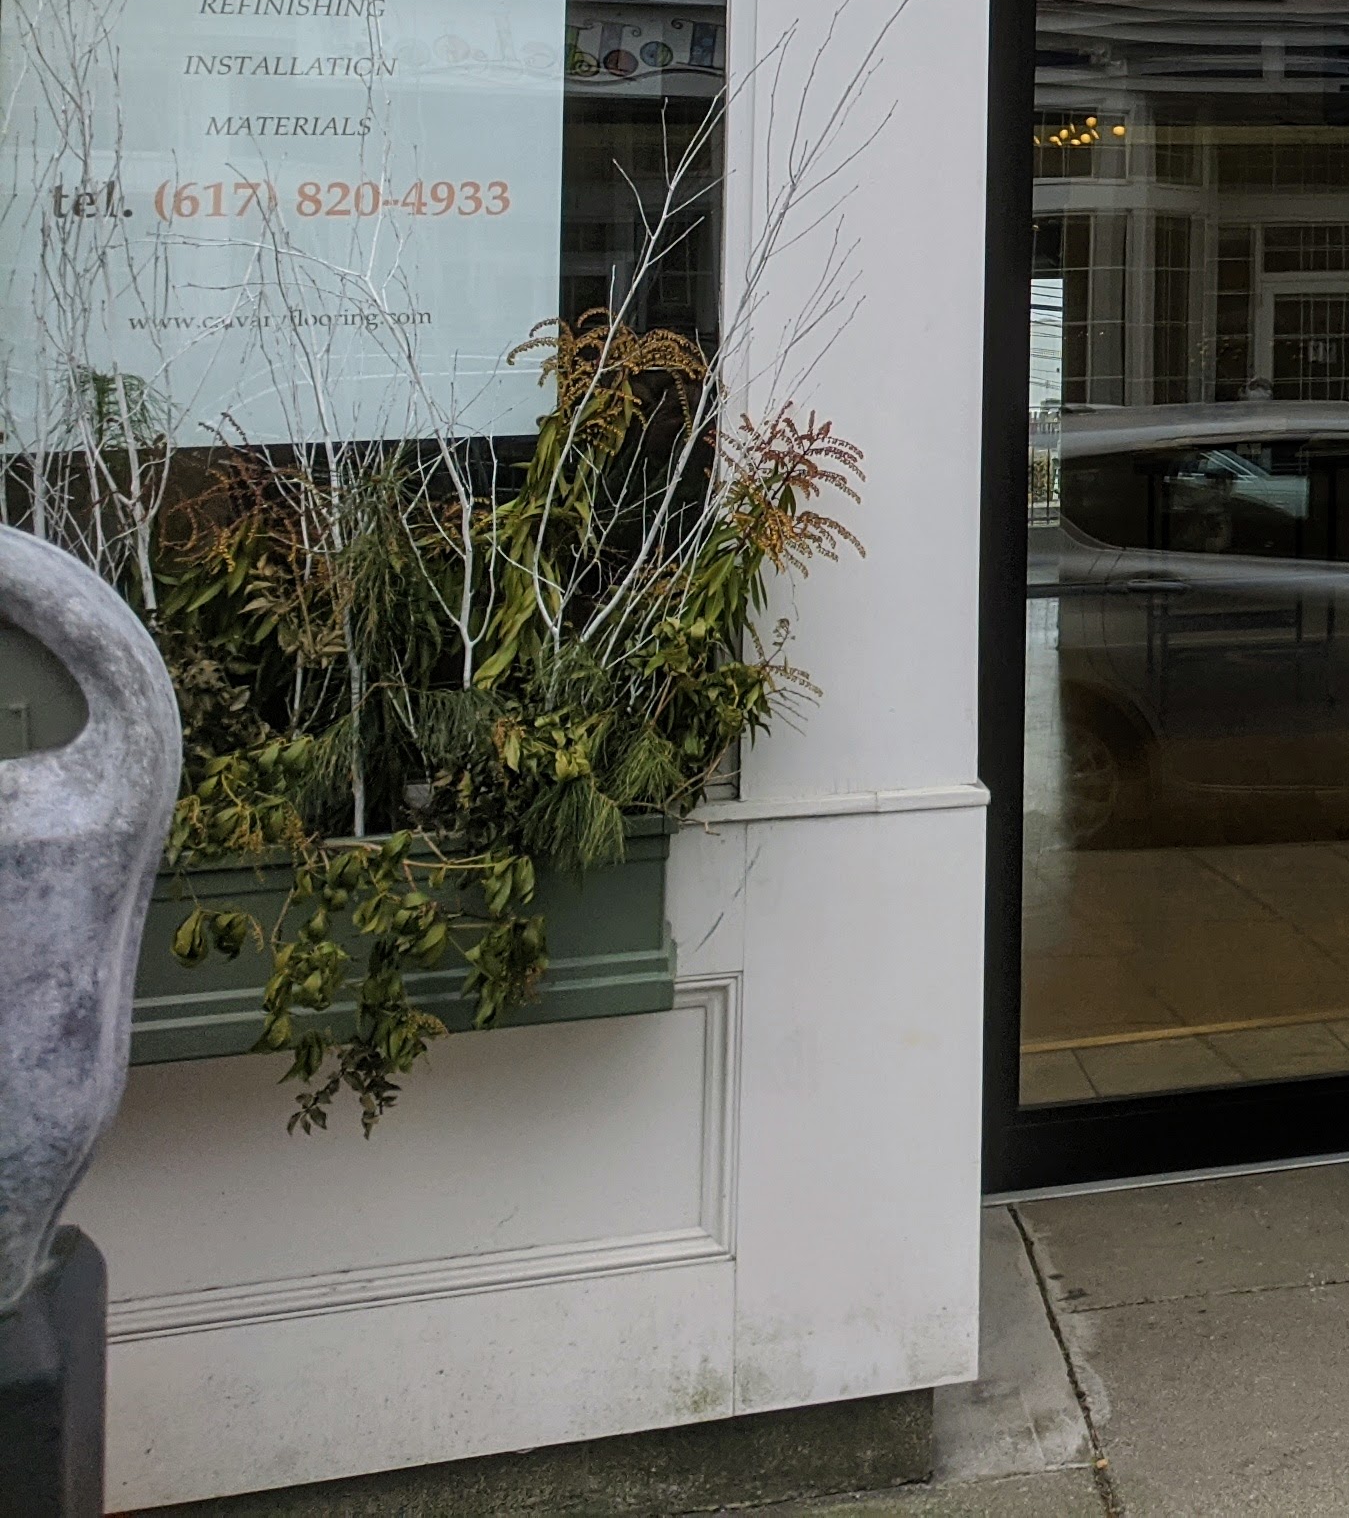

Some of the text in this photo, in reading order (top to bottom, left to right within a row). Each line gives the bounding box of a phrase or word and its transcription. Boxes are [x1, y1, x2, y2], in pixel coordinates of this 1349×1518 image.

[182, 55, 399, 78] INSTALLATION
[205, 115, 372, 138] MATERIALS
[53, 178, 511, 222] tel. (617) 820-4933
